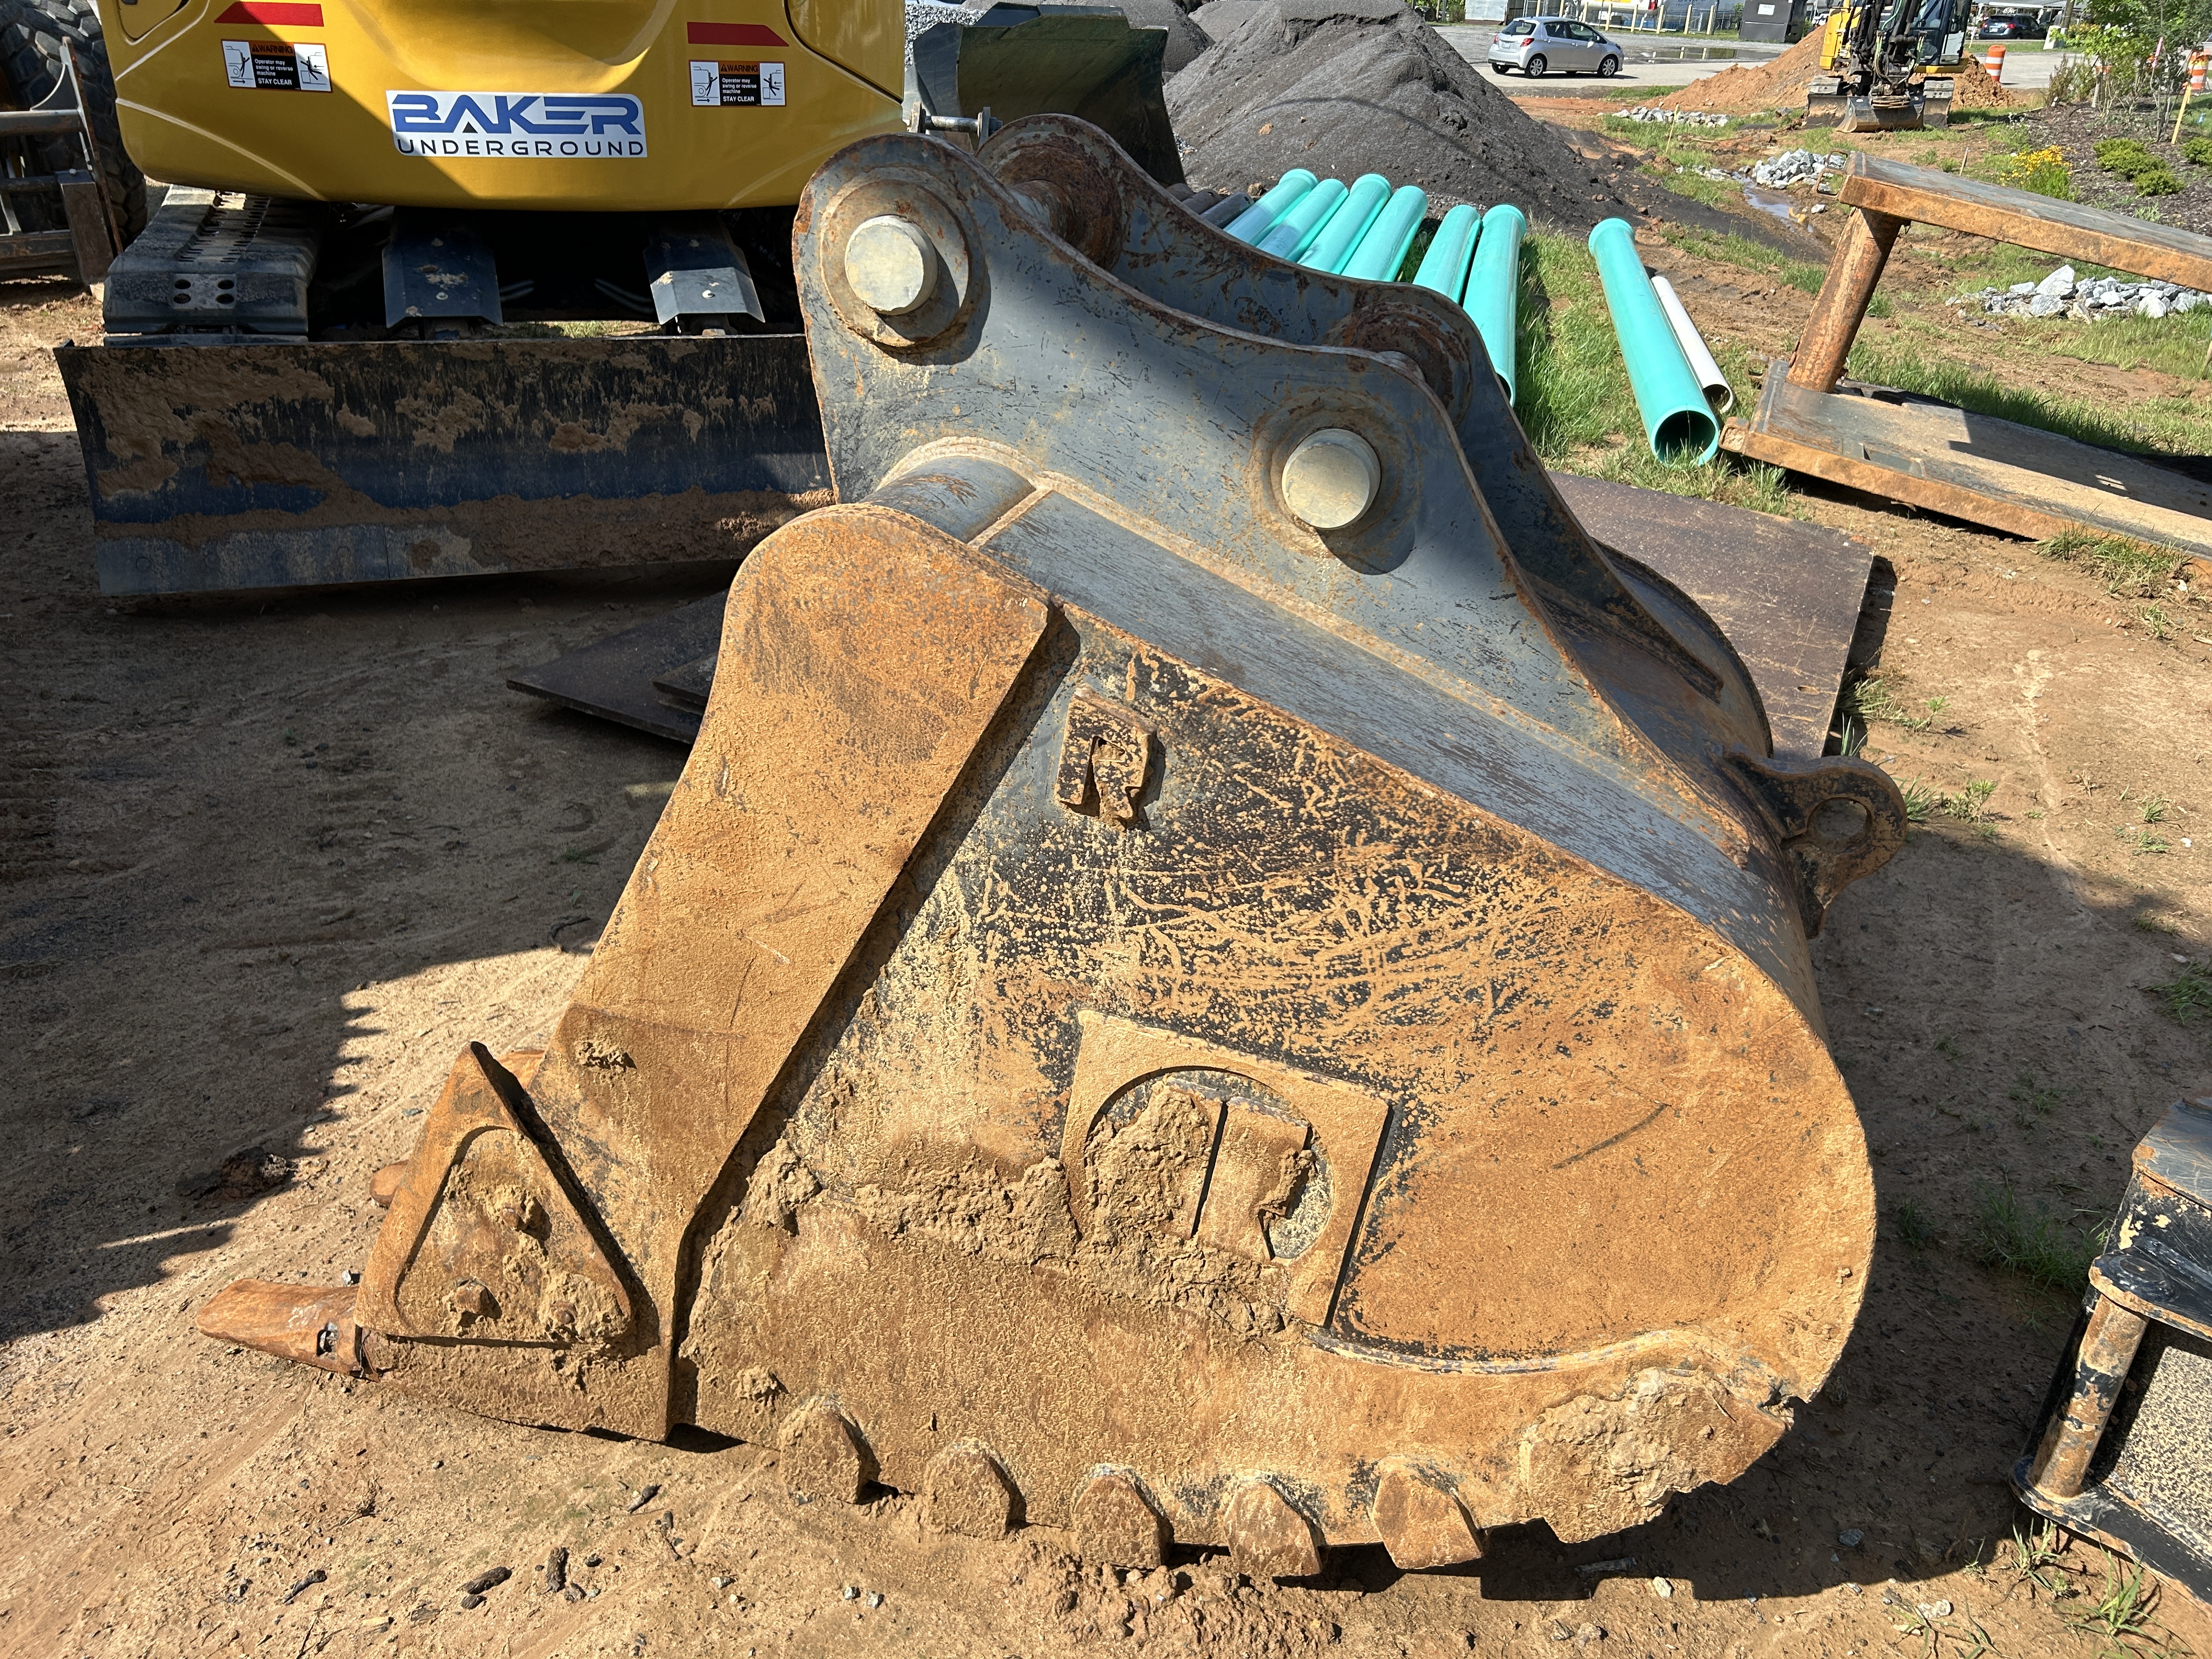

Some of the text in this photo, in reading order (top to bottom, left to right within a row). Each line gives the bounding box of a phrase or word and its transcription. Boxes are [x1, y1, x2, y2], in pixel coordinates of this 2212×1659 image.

[257, 44, 293, 54] WARNING
[392, 94, 641, 134] BAKER
[397, 139, 644, 155] UNDERGROUND
